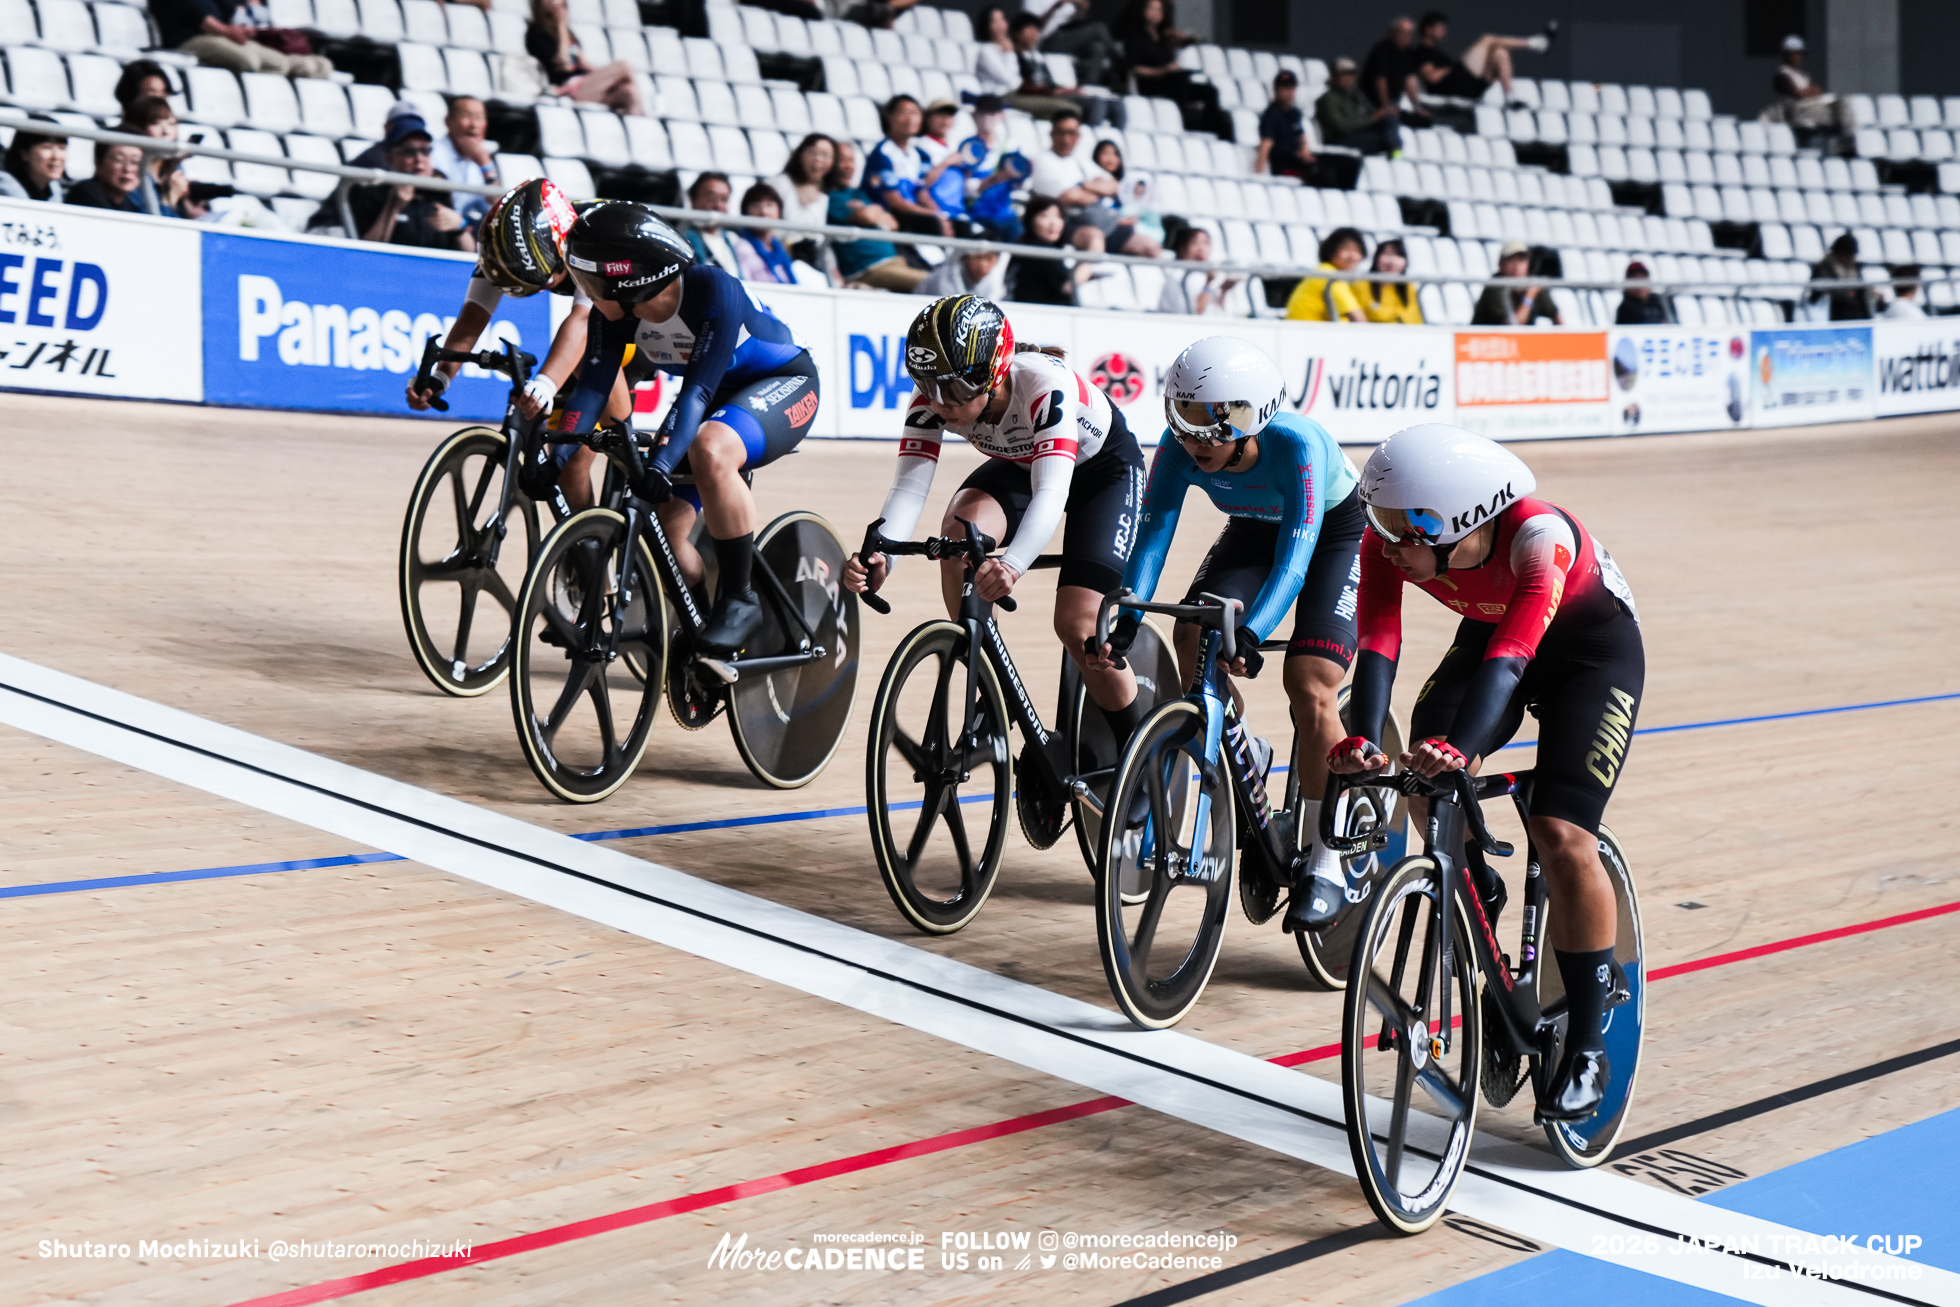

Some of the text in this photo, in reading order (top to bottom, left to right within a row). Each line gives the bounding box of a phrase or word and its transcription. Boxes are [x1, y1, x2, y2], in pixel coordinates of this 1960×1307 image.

[509, 204, 537, 271] Kabuto
[606, 262, 630, 273] Fitty
[618, 262, 680, 289] Kabuto
[0, 339, 117, 378] ンネル
[1176, 390, 1196, 401] KASK
[1328, 357, 1441, 410] vittoria
[783, 389, 819, 429] TAIKEN
[1258, 386, 1288, 425] KASK
[1076, 416, 1103, 439] ANCHOR
[1298, 462, 1316, 525] bossini.X
[1359, 487, 1373, 502] KASK
[1451, 481, 1516, 535] KASK
[1292, 528, 1316, 543] HKG
[649, 511, 703, 628] BRIDGESTONE
[1193, 637, 1209, 687] FACTOR
[1289, 638, 1355, 666] bossini.X
[986, 616, 1050, 746] BRIDGESTONE
[1585, 685, 1636, 788] CHINA
[1462, 867, 1516, 993] ARGON 18
